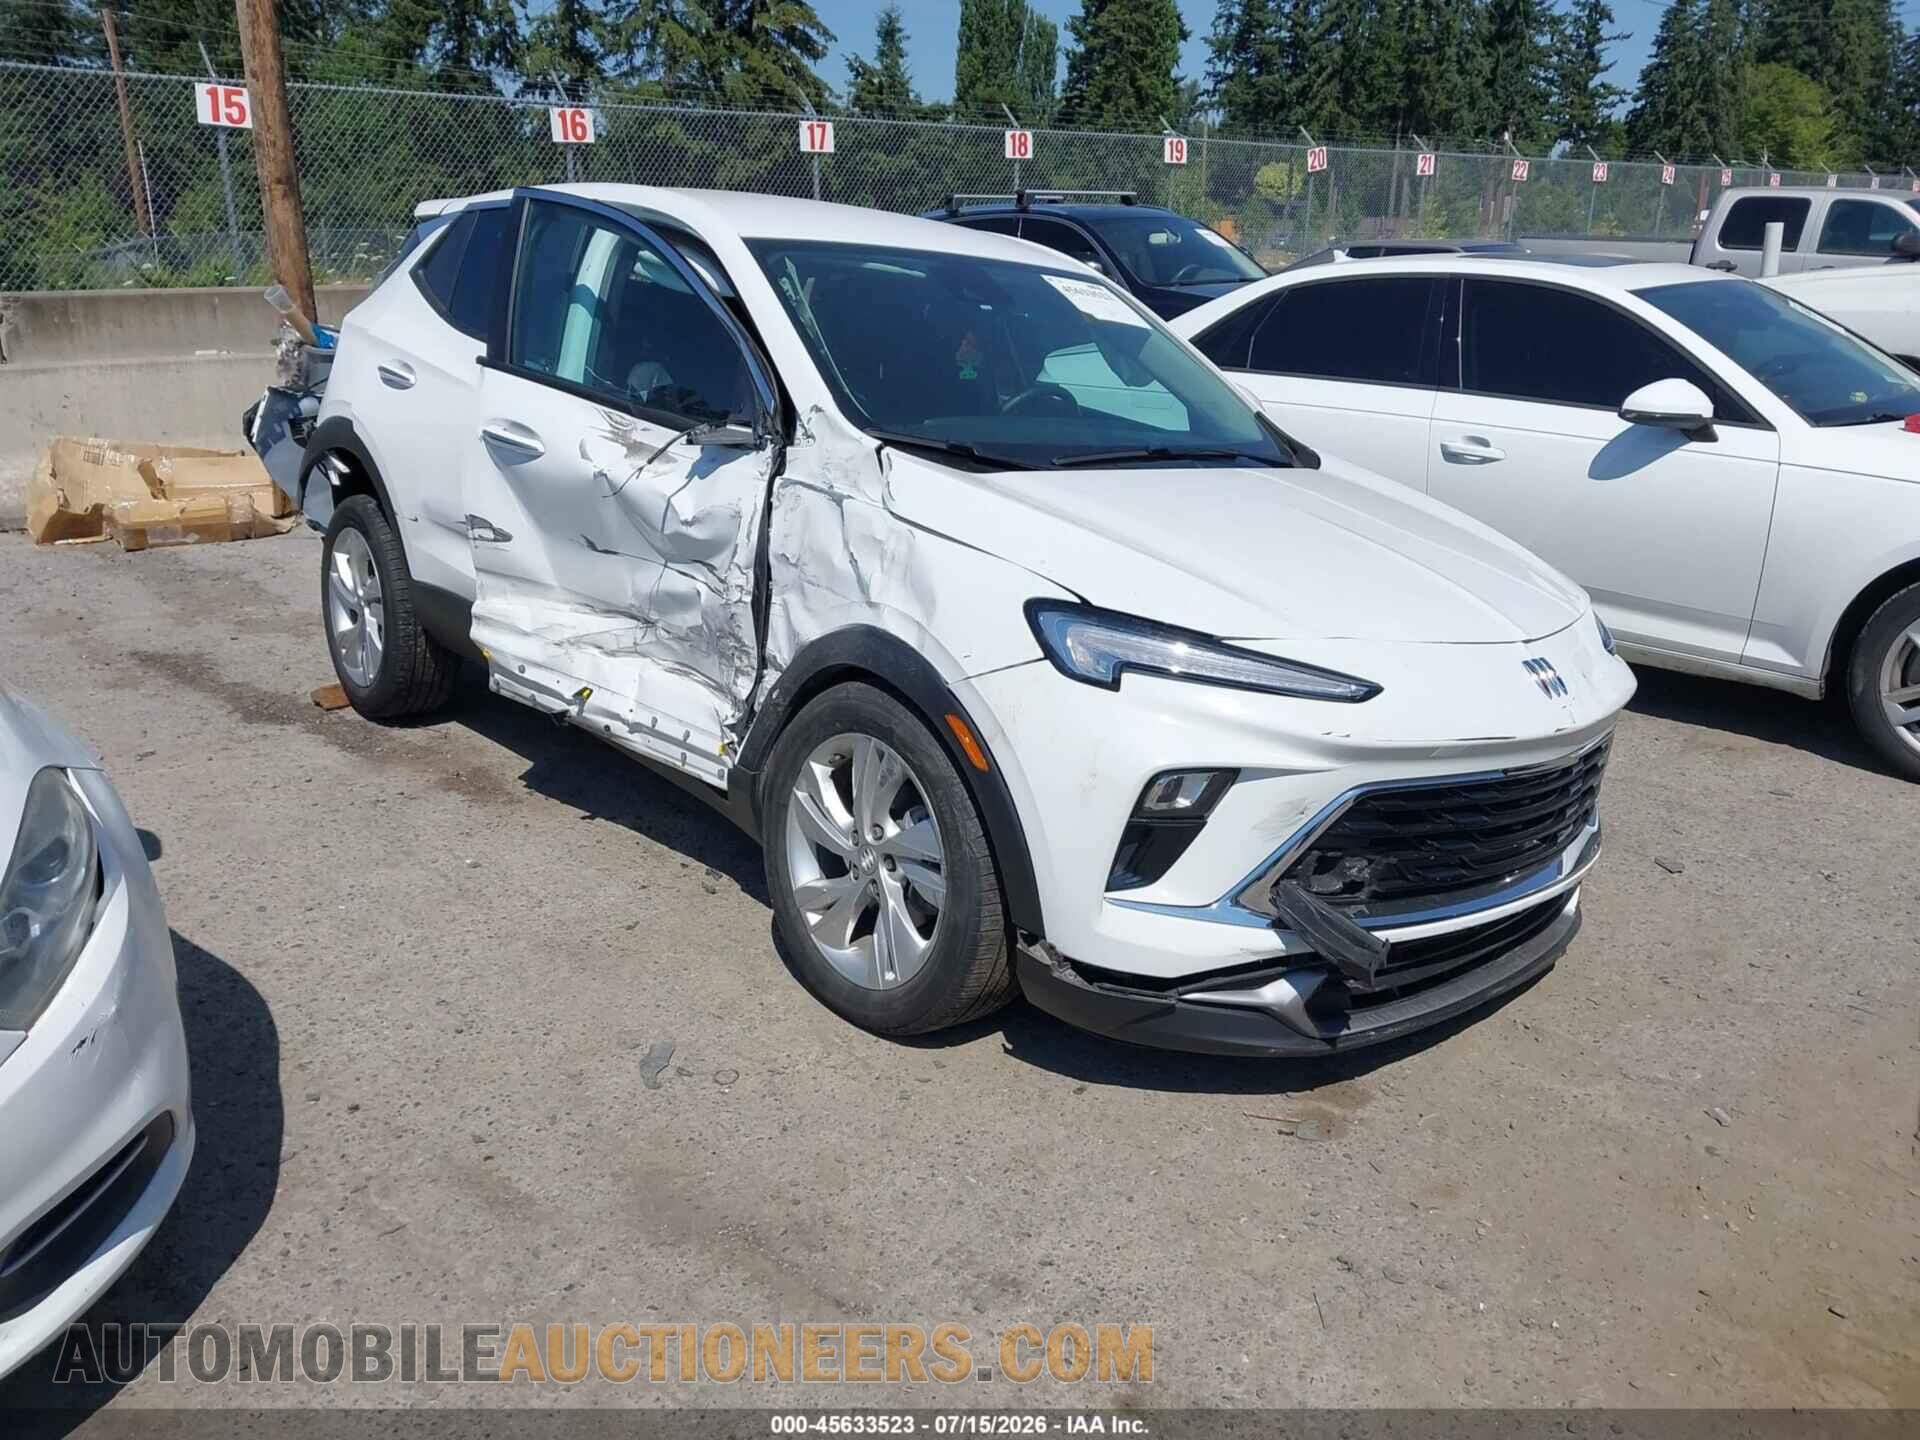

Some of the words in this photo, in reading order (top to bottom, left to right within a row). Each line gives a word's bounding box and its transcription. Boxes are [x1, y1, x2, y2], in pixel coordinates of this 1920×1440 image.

[206, 87, 247, 125] 15
[558, 110, 587, 141] 16
[807, 123, 826, 150] 17
[1010, 132, 1028, 157] 18
[1169, 140, 1184, 162] 19
[1310, 148, 1325, 170] 20
[1419, 155, 1431, 174] 21
[1513, 161, 1527, 179] 22
[1594, 164, 1606, 180] 23
[1663, 167, 1674, 182] 24
